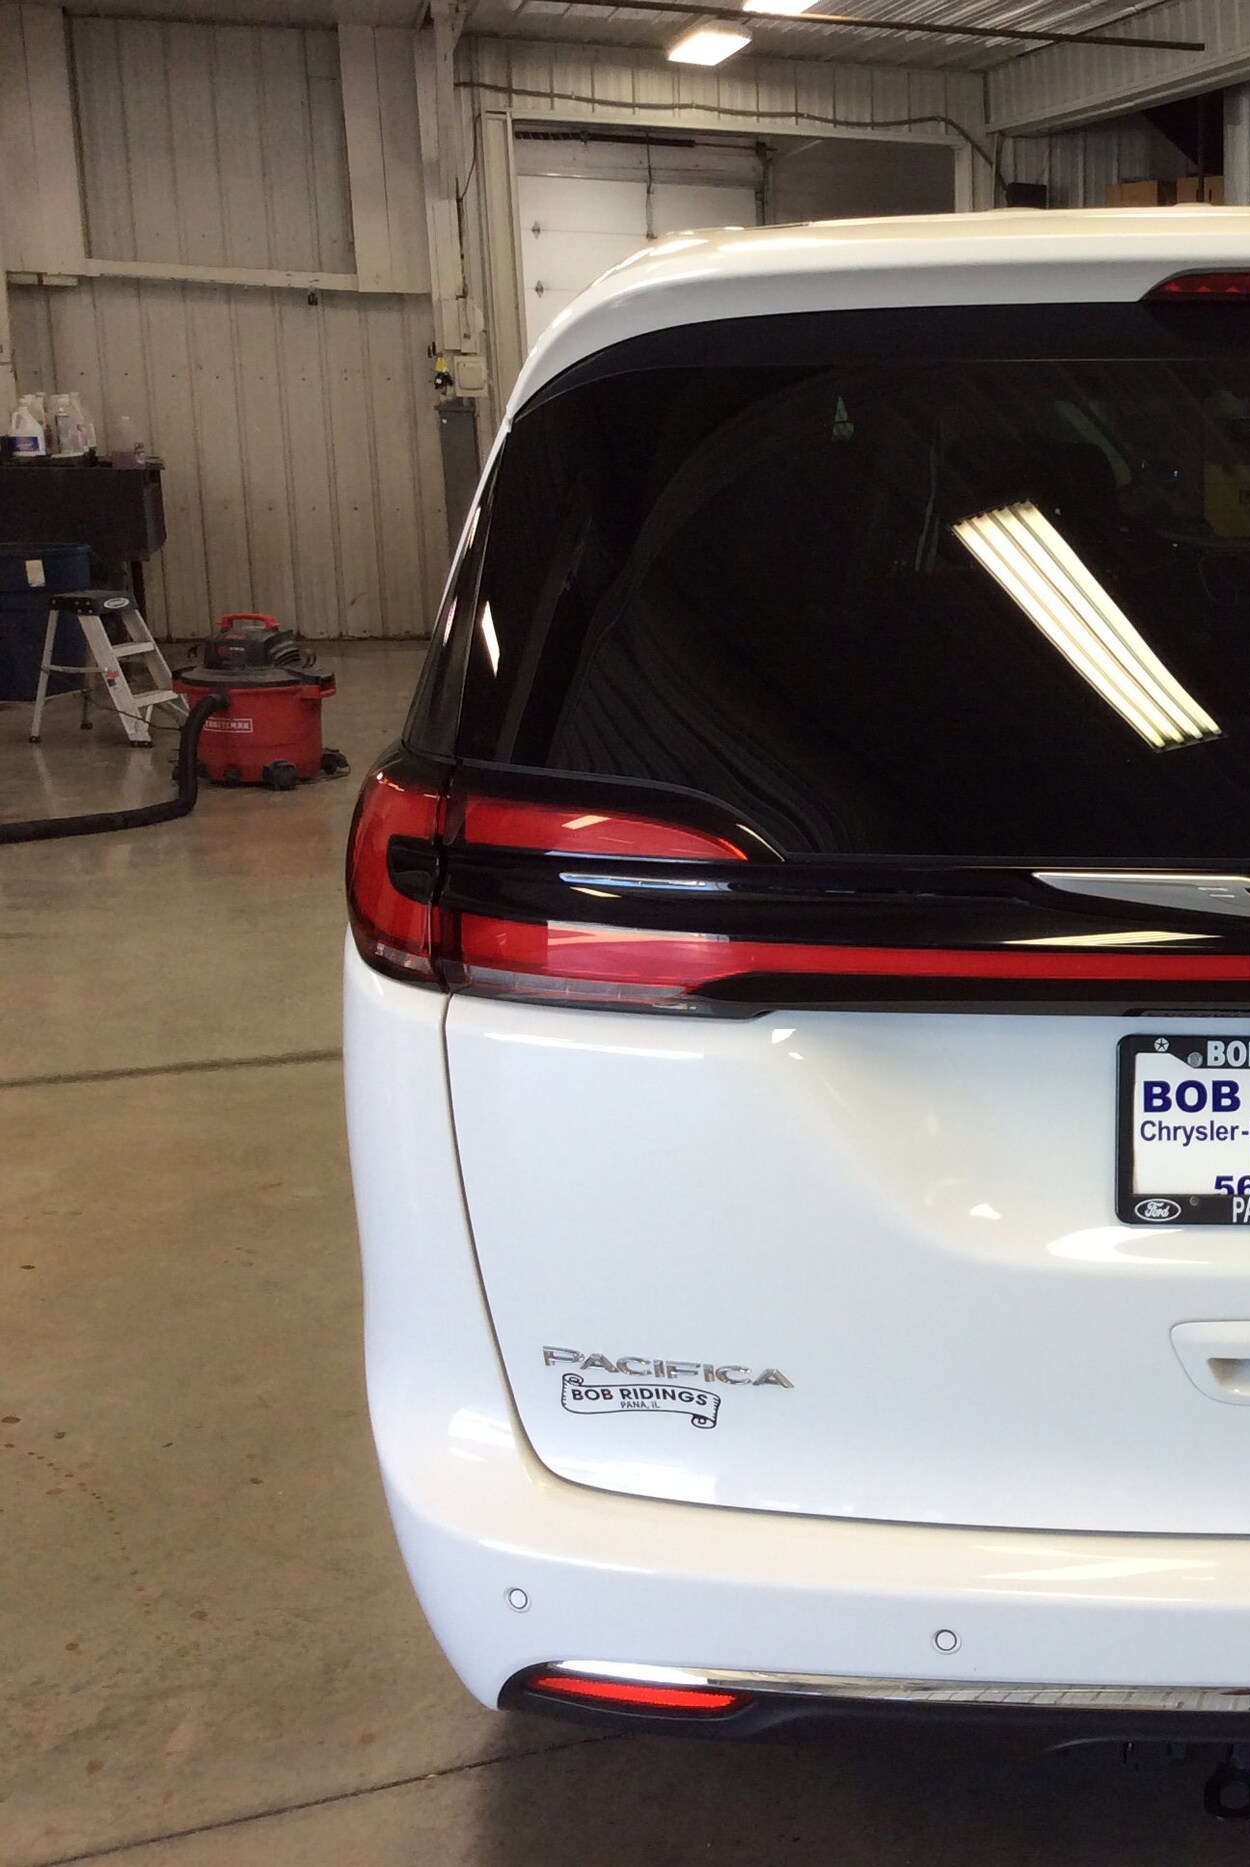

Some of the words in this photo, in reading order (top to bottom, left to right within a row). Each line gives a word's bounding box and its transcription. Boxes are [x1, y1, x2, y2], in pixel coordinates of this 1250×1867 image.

[1143, 1079, 1241, 1113] BOB
[542, 1345, 795, 1389] PACIFICA
[571, 1388, 614, 1401] BOB
[619, 1388, 709, 1406] RIDINGS
[620, 1401, 650, 1410] PANA,
